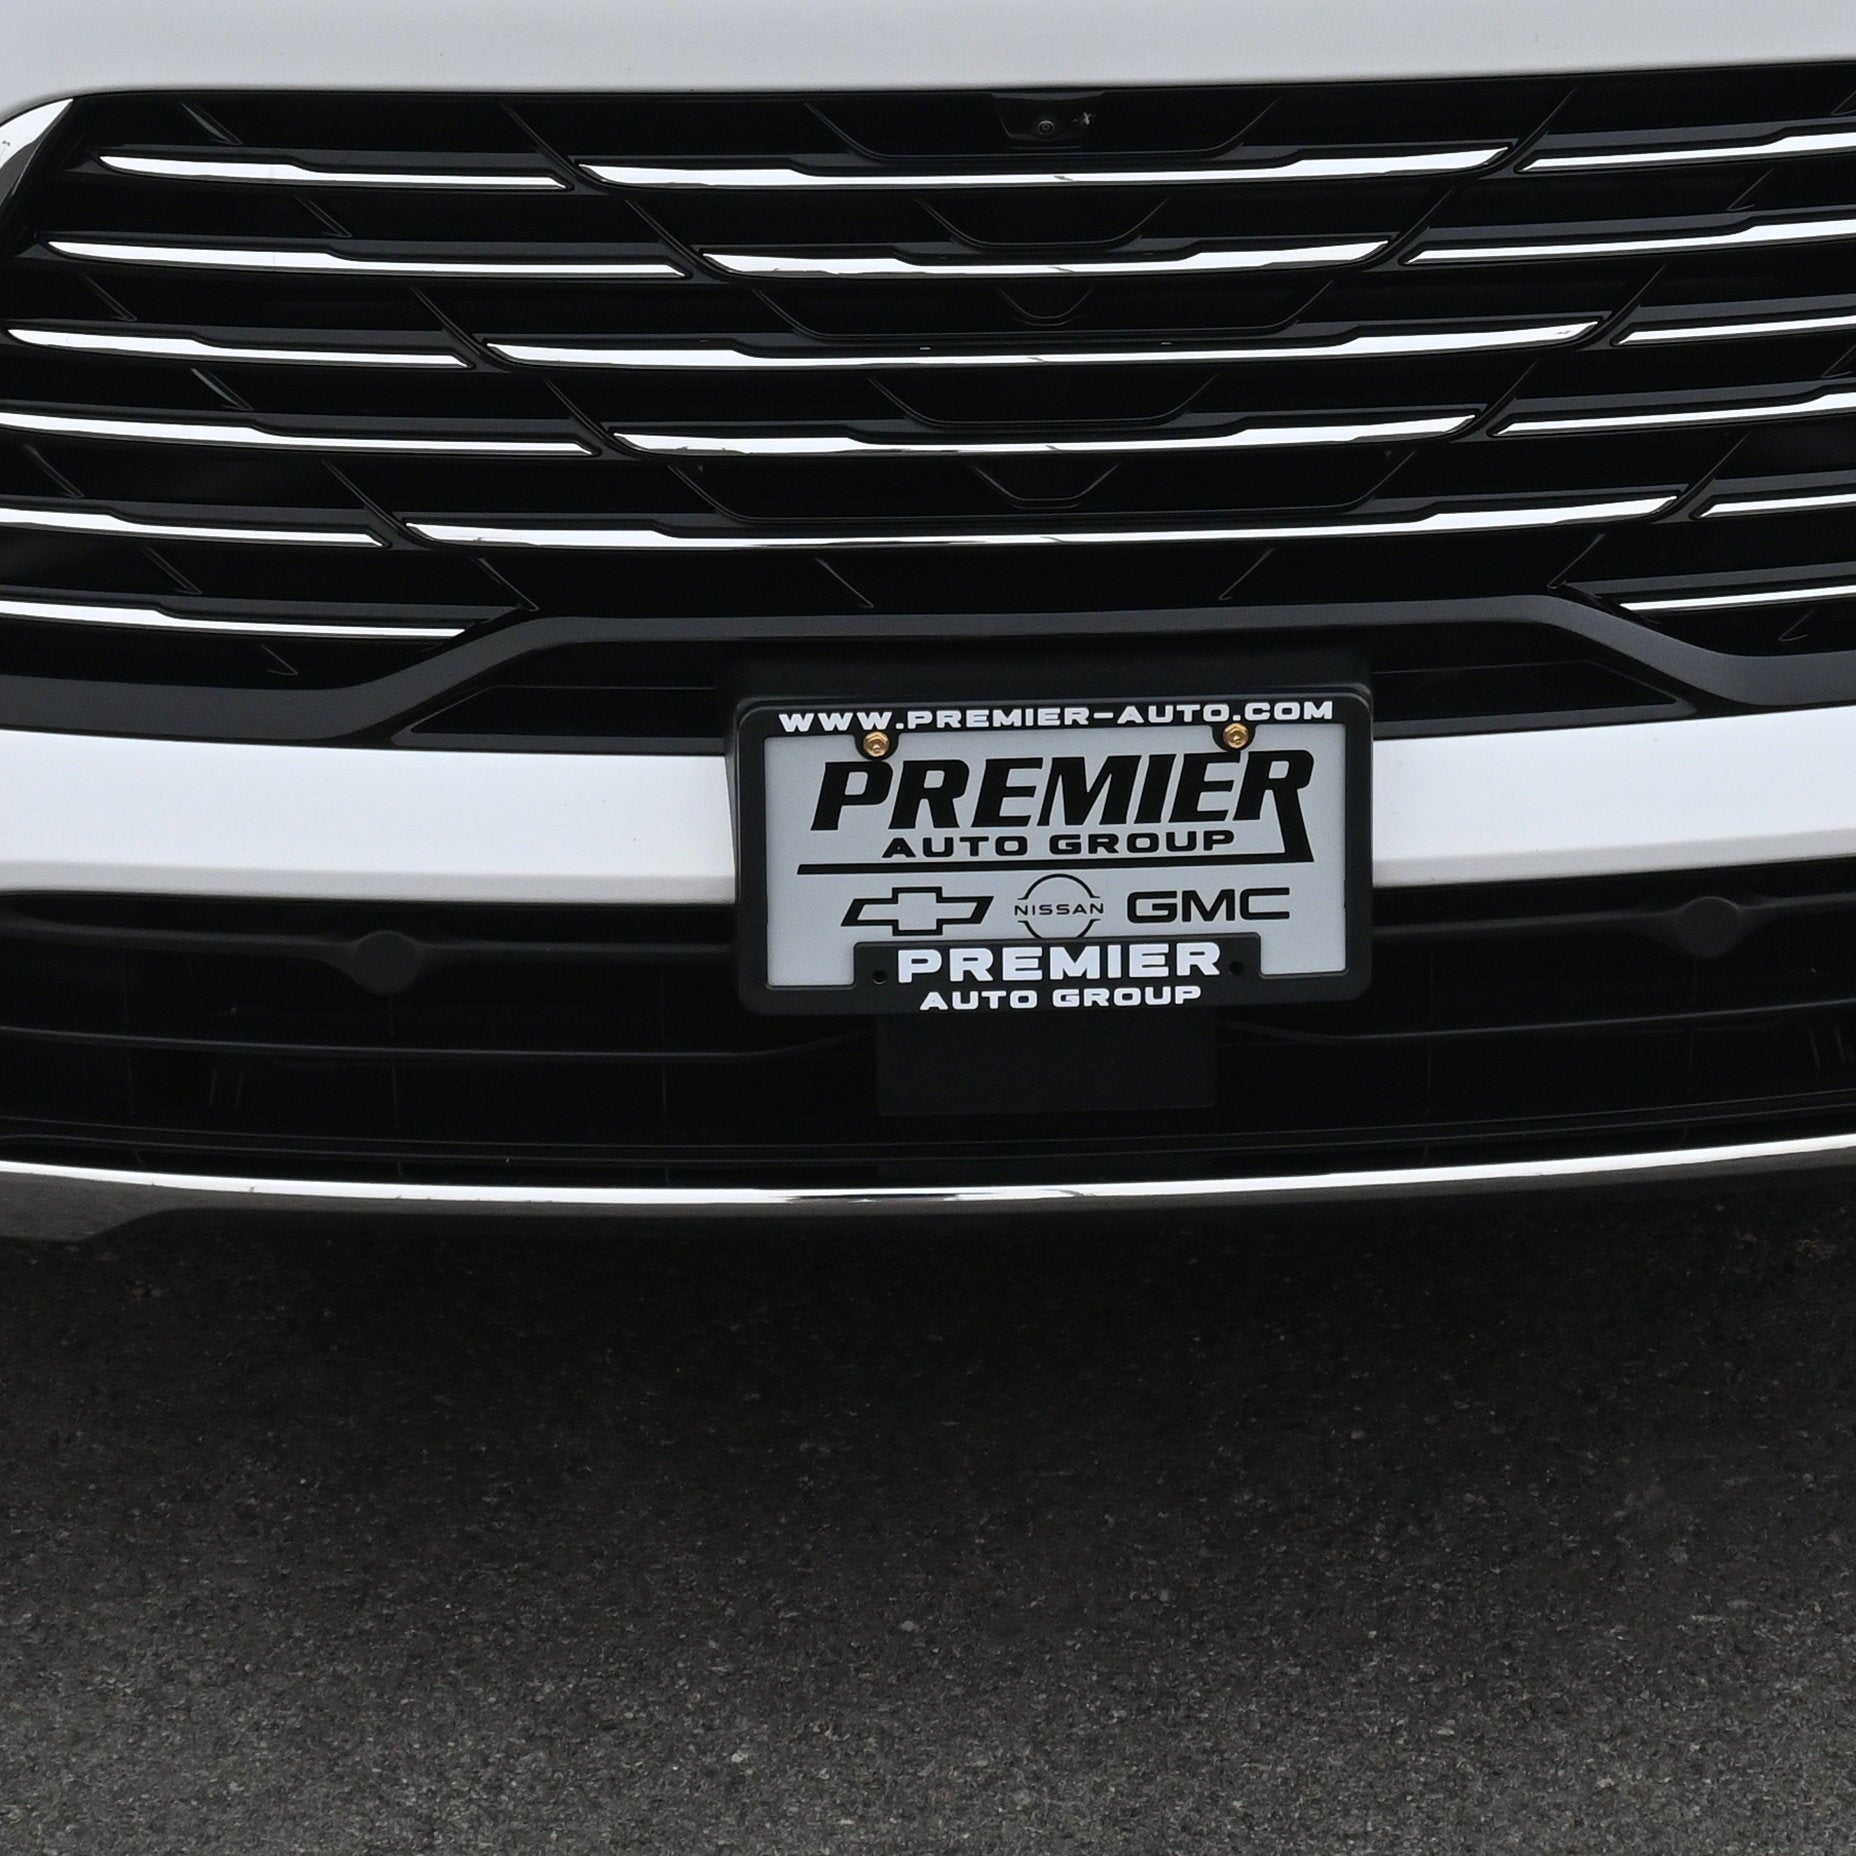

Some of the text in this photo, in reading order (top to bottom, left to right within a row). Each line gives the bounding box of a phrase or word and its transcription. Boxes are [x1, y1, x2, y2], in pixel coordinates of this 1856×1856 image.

[779, 700, 1333, 733] WWW.PREMIER-AUTO.COM
[810, 749, 1315, 862] PREMIER
[882, 829, 1235, 859] AUTO GROUP
[1014, 902, 1104, 916] NISSAN
[1127, 887, 1290, 924] GMC
[897, 941, 1221, 984] PREMIER
[919, 985, 1202, 1012] AUTO GROUP
